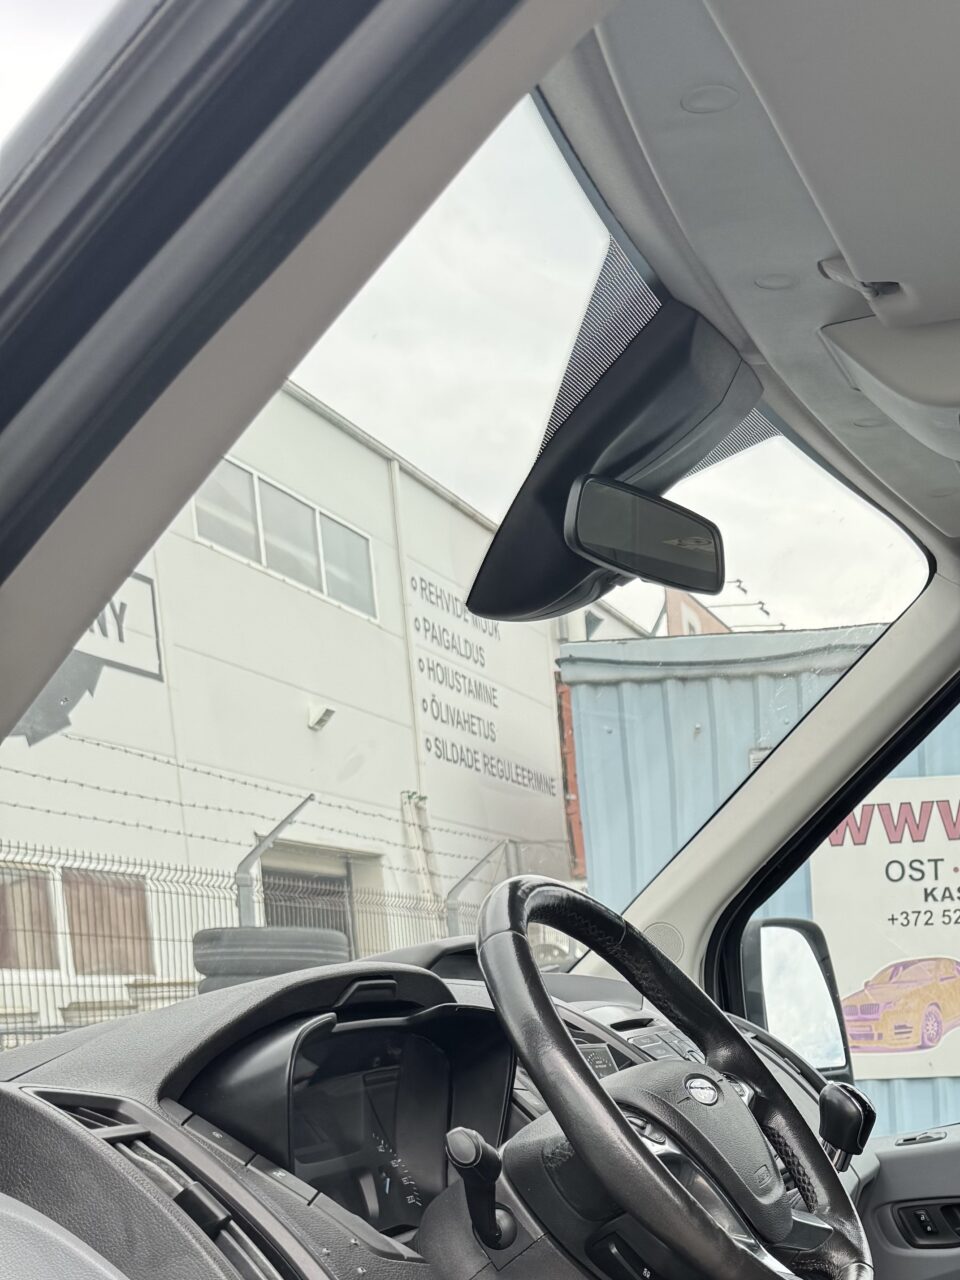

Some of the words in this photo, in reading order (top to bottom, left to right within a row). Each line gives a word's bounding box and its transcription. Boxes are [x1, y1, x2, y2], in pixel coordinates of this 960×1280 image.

[423, 616, 486, 667] PAIGALDUS
[427, 657, 499, 708] HOIUSTAMINE
[430, 693, 497, 742] ÕLIVAHETUS
[434, 737, 481, 772] SILDADE
[483, 754, 557, 797] REGULEERIMINE
[885, 858, 944, 882] OST
[887, 910, 934, 927] +372
